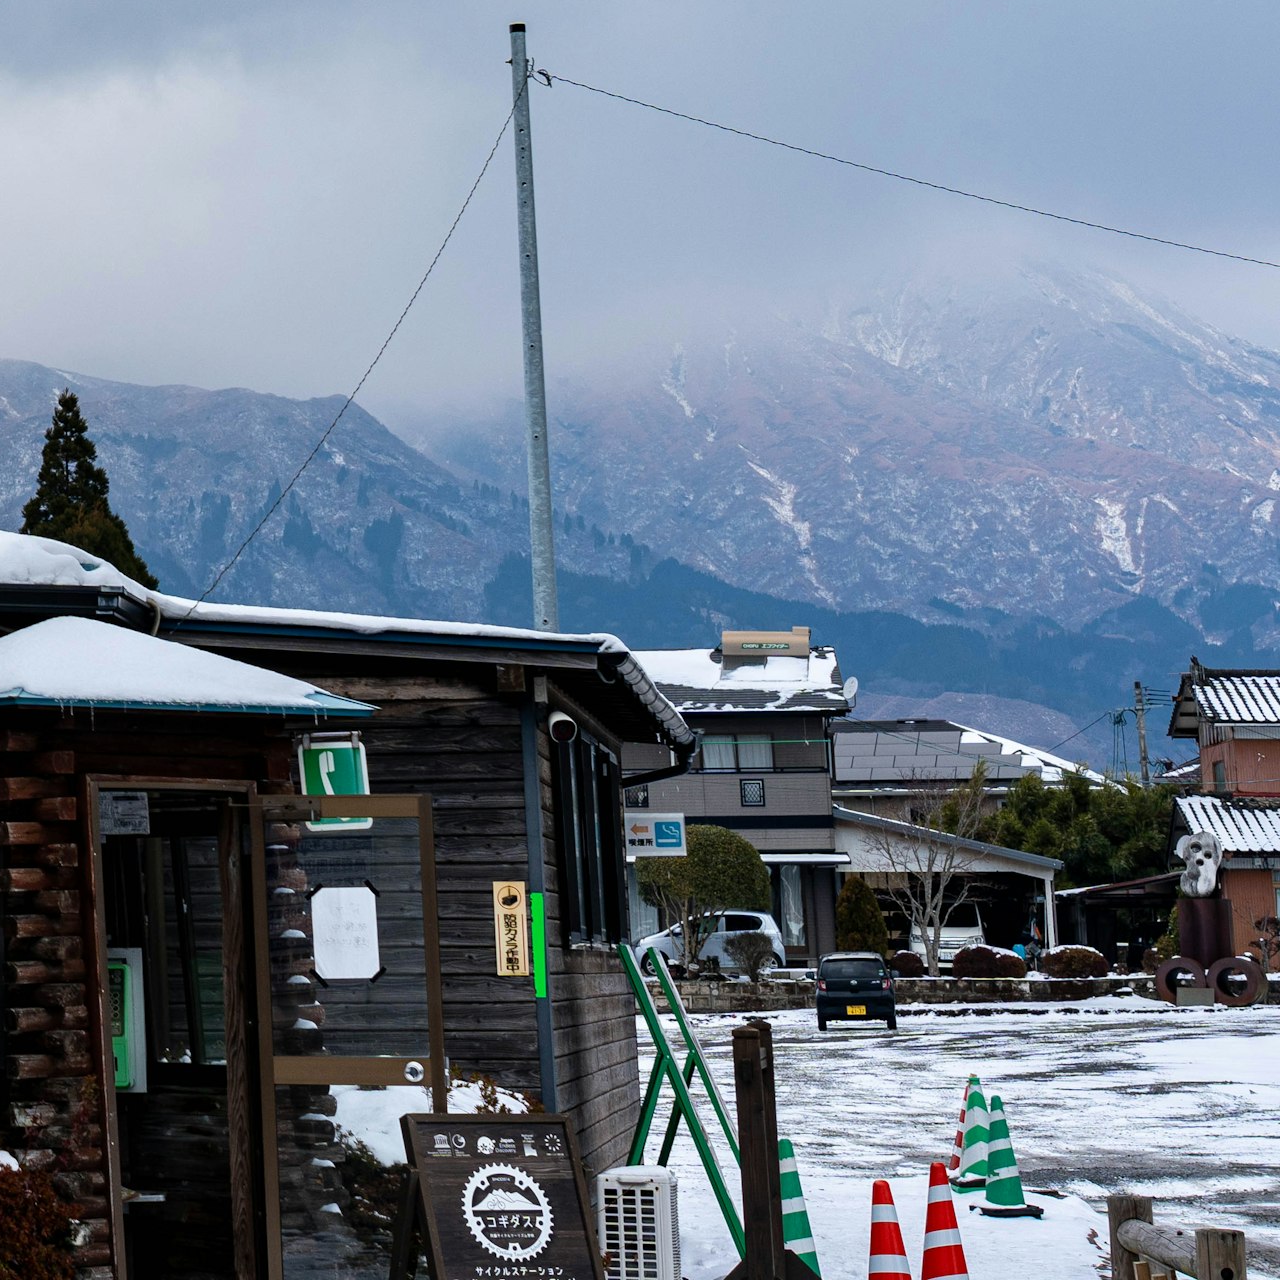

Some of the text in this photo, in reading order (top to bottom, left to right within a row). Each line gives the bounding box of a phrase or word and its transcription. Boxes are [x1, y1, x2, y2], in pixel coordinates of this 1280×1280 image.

[503, 913, 520, 974] 防犯カメラ作動中
[486, 1215, 534, 1228] コギダス
[475, 1266, 563, 1276] サイクルステーション
